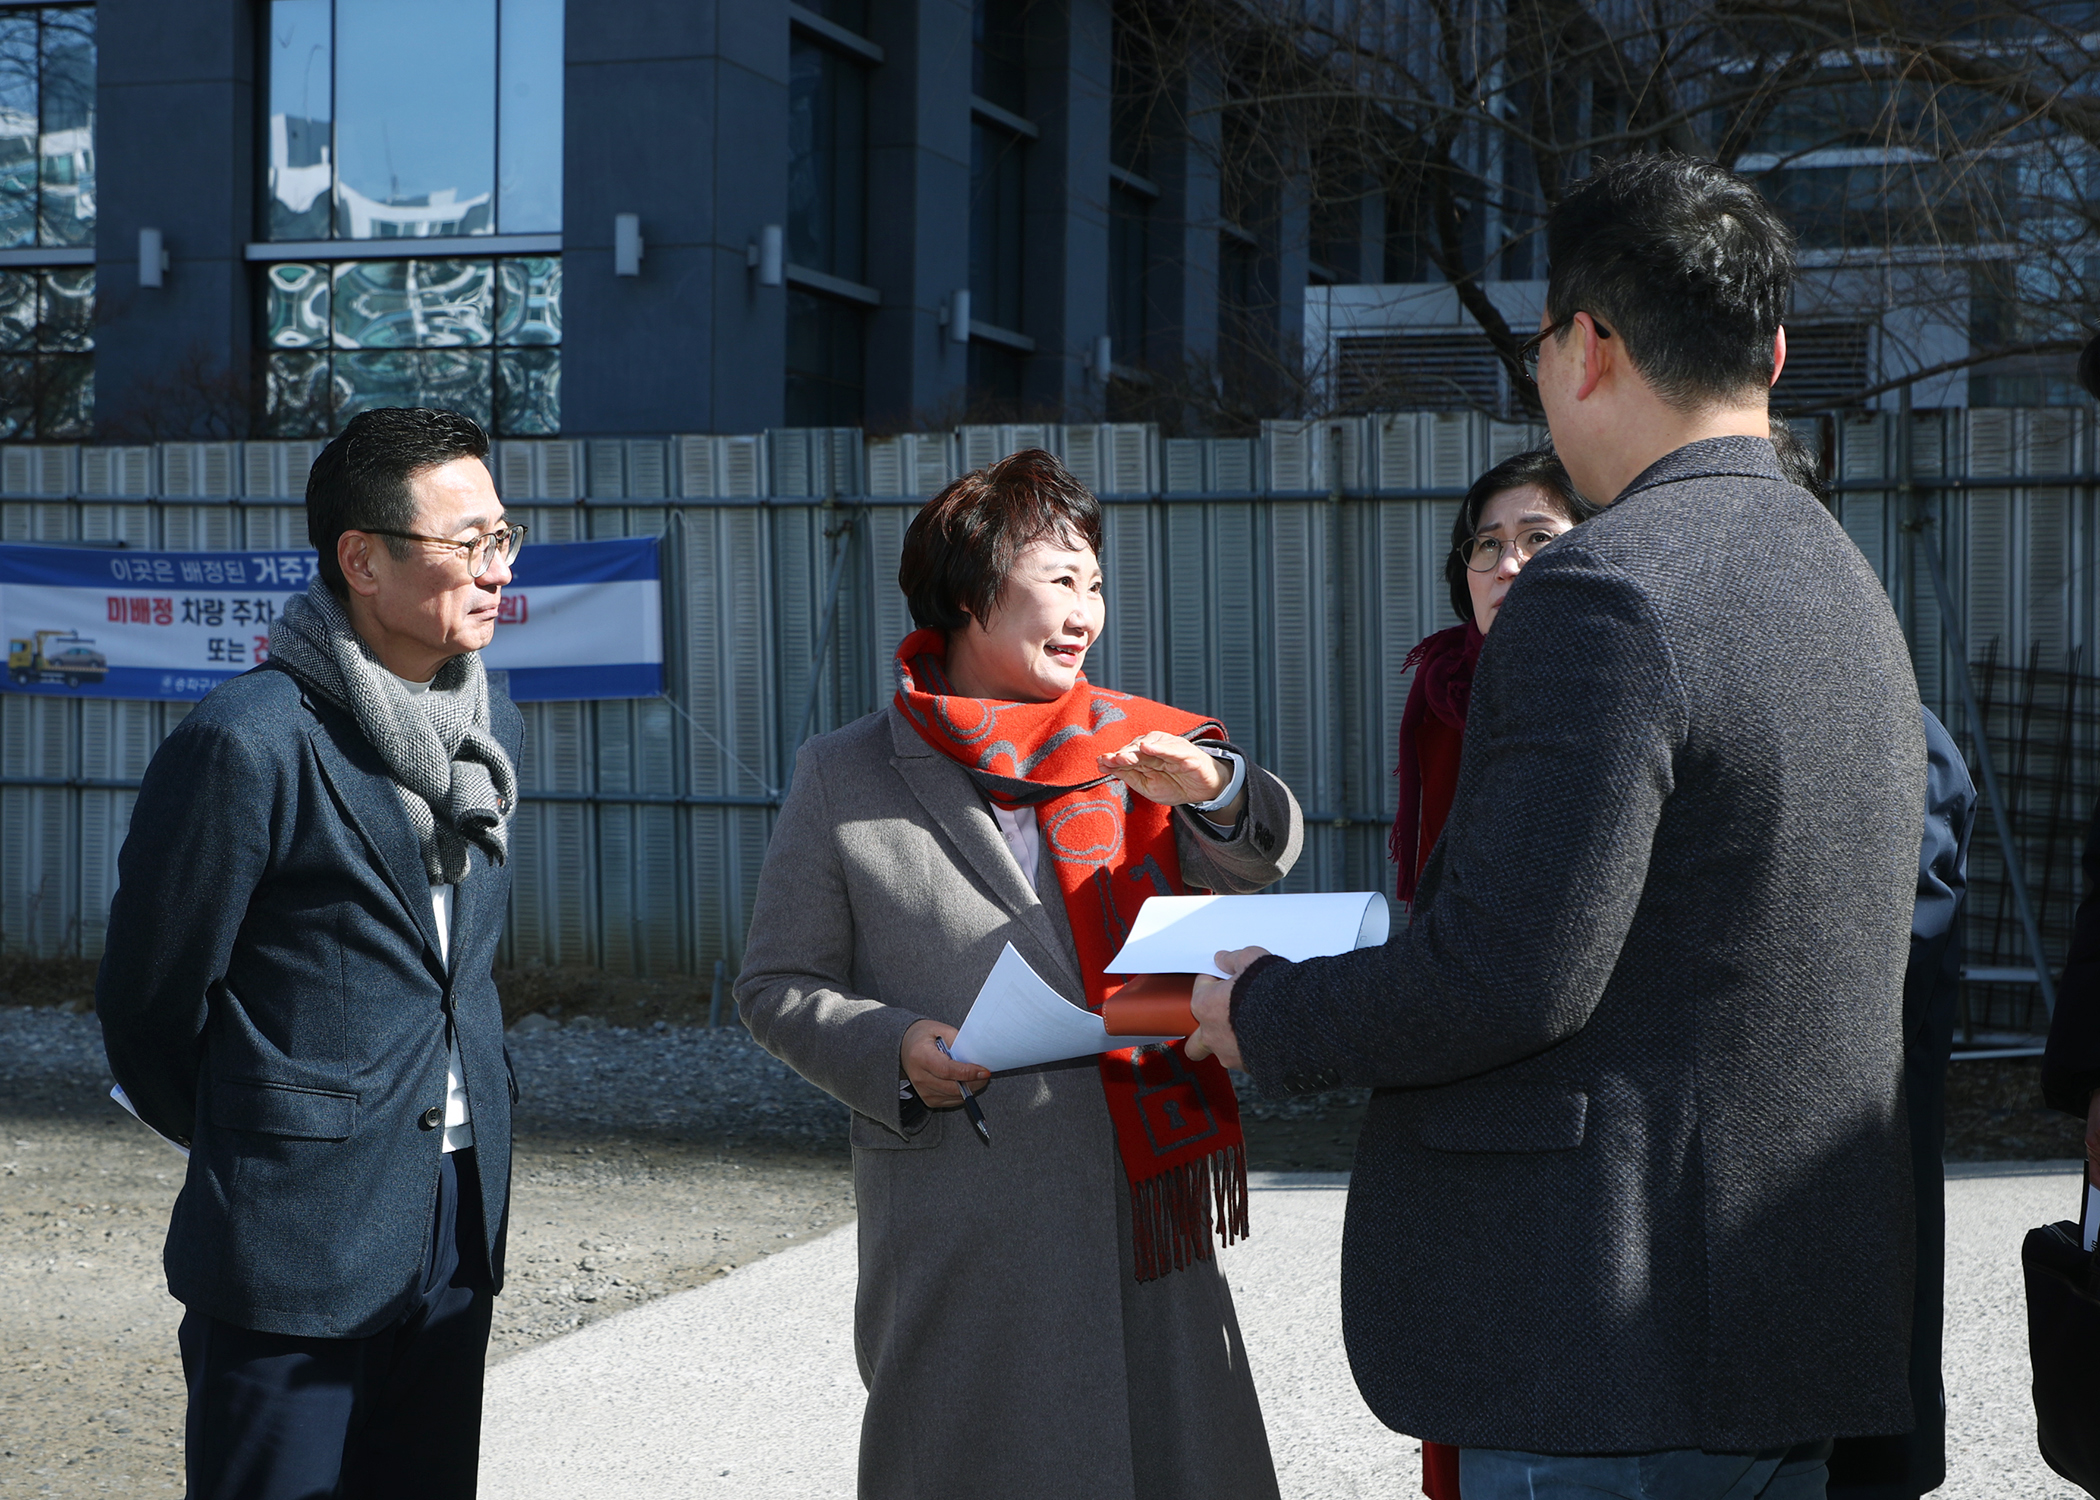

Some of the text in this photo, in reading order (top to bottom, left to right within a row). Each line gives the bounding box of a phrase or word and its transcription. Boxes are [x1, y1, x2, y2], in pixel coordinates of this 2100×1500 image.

[110, 557, 175, 583] 이곳은
[179, 560, 247, 585] 배정된
[106, 596, 174, 627] 미배정
[180, 597, 226, 628] 차량
[231, 599, 275, 628] 주차
[207, 637, 247, 665] 또는
